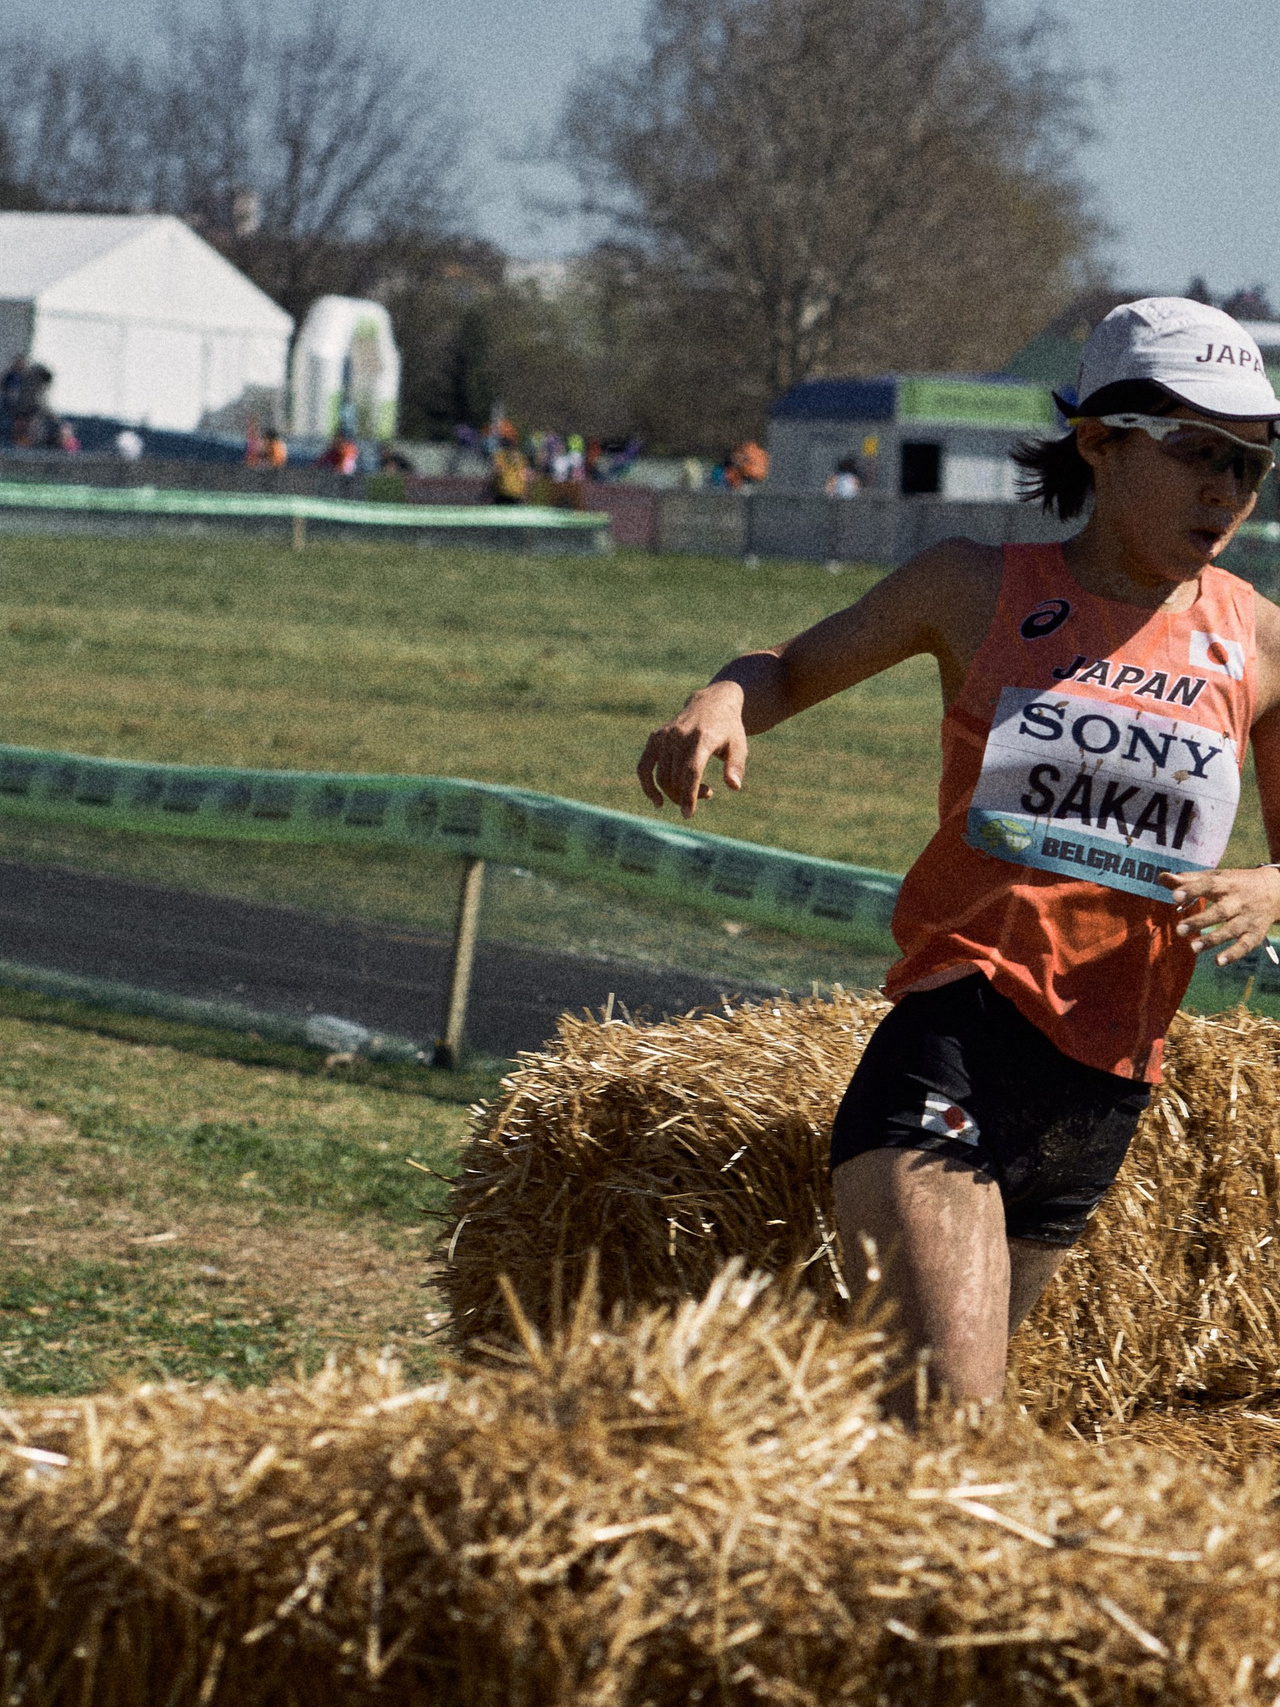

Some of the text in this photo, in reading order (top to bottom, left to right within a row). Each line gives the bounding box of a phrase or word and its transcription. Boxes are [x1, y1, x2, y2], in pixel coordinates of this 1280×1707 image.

[1052, 655, 1207, 707] JAPAN
[1018, 702, 1223, 779] SONY
[1020, 763, 1196, 850] SAKAI
